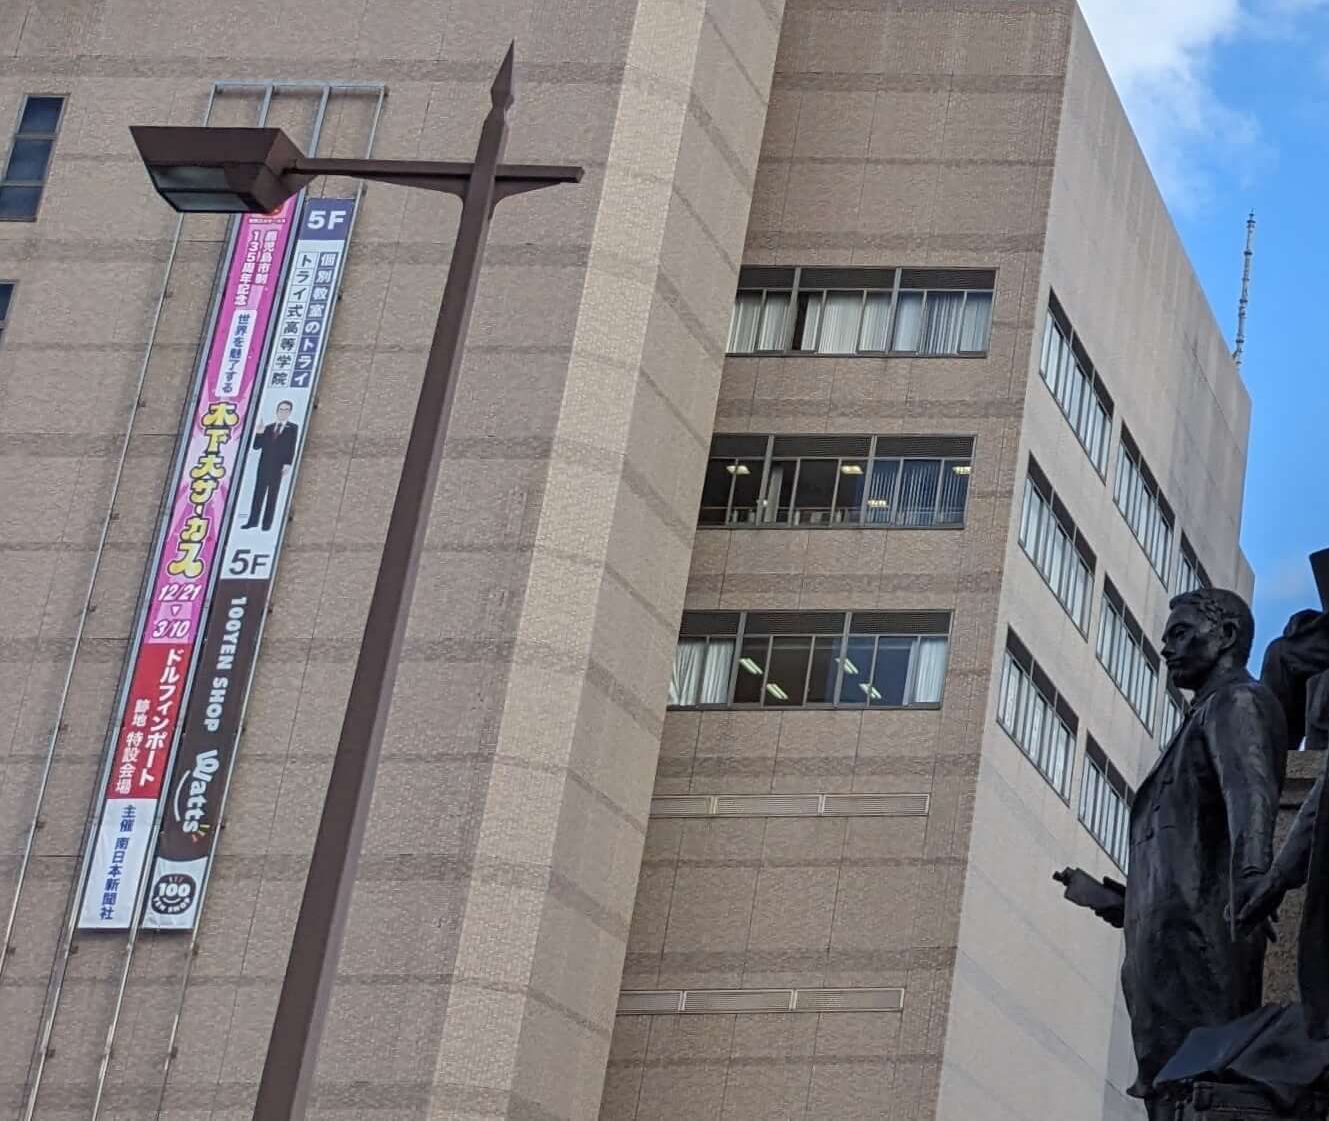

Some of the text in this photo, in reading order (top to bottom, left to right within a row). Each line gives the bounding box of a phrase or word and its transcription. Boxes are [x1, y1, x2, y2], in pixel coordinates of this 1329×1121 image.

[307, 210, 347, 230] 5F
[221, 313, 251, 394] 世界を魅了する
[271, 254, 312, 386] トライ式高等学院
[293, 253, 337, 386] 個別教室のトライ
[167, 402, 240, 578] 木下大サーカス
[158, 583, 203, 602] 12/21
[229, 549, 269, 576] 5F
[153, 620, 191, 638] 3/10
[203, 596, 248, 732] 100YEN SHOP
[139, 648, 184, 788] ドルフィンポート
[99, 805, 137, 921] 主催 南日本新聞社
[159, 882, 191, 898] 100
